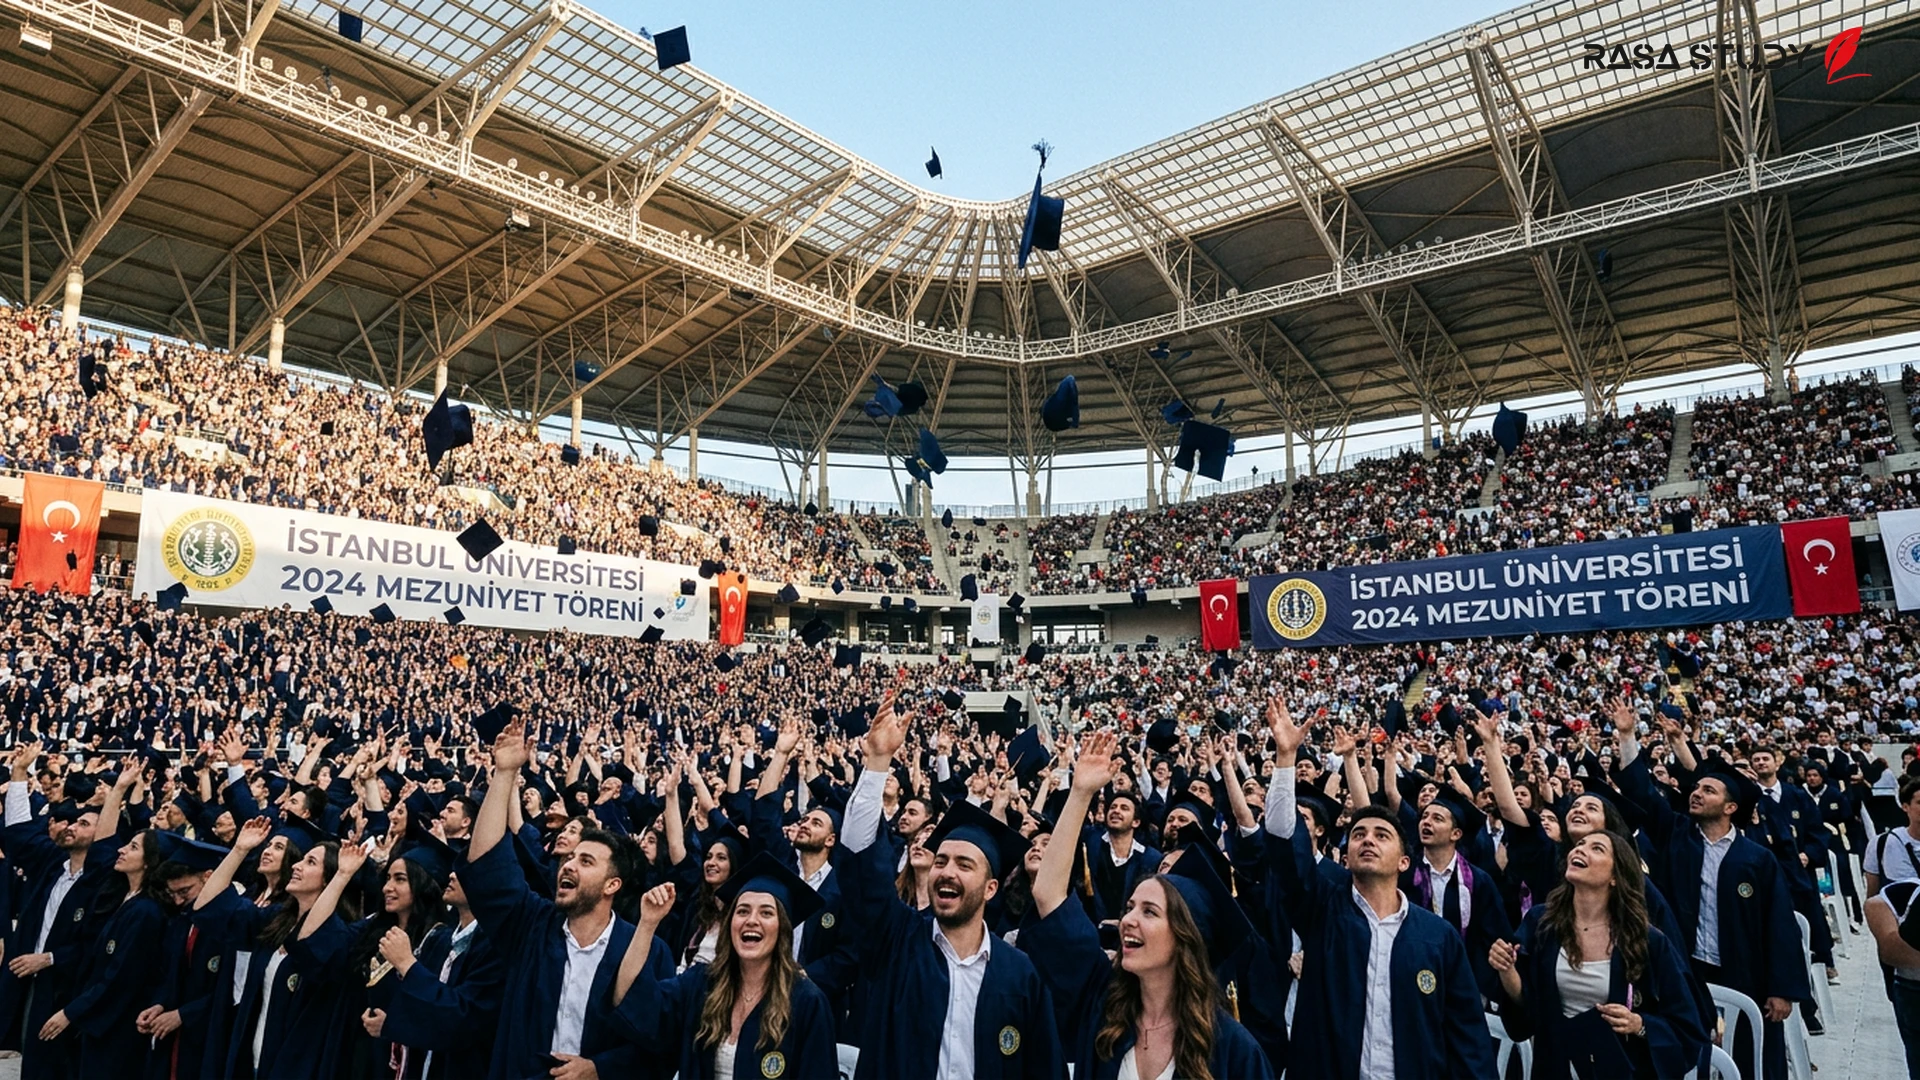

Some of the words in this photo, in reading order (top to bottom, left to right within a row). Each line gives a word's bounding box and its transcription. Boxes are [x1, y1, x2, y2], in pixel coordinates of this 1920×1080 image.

[287, 519, 454, 571] İSTANBUL
[1350, 567, 1497, 601] İSTANBUL
[1503, 536, 1744, 588] ÜNİVERSİTESİ
[280, 565, 366, 597] 2024
[376, 574, 546, 613] MEZUNİYET
[553, 590, 644, 622] TÖRENİ
[1351, 605, 1420, 631] 2024
[1426, 589, 1607, 626] MEZUNİYET
[1614, 572, 1750, 612] TÖRENİ
